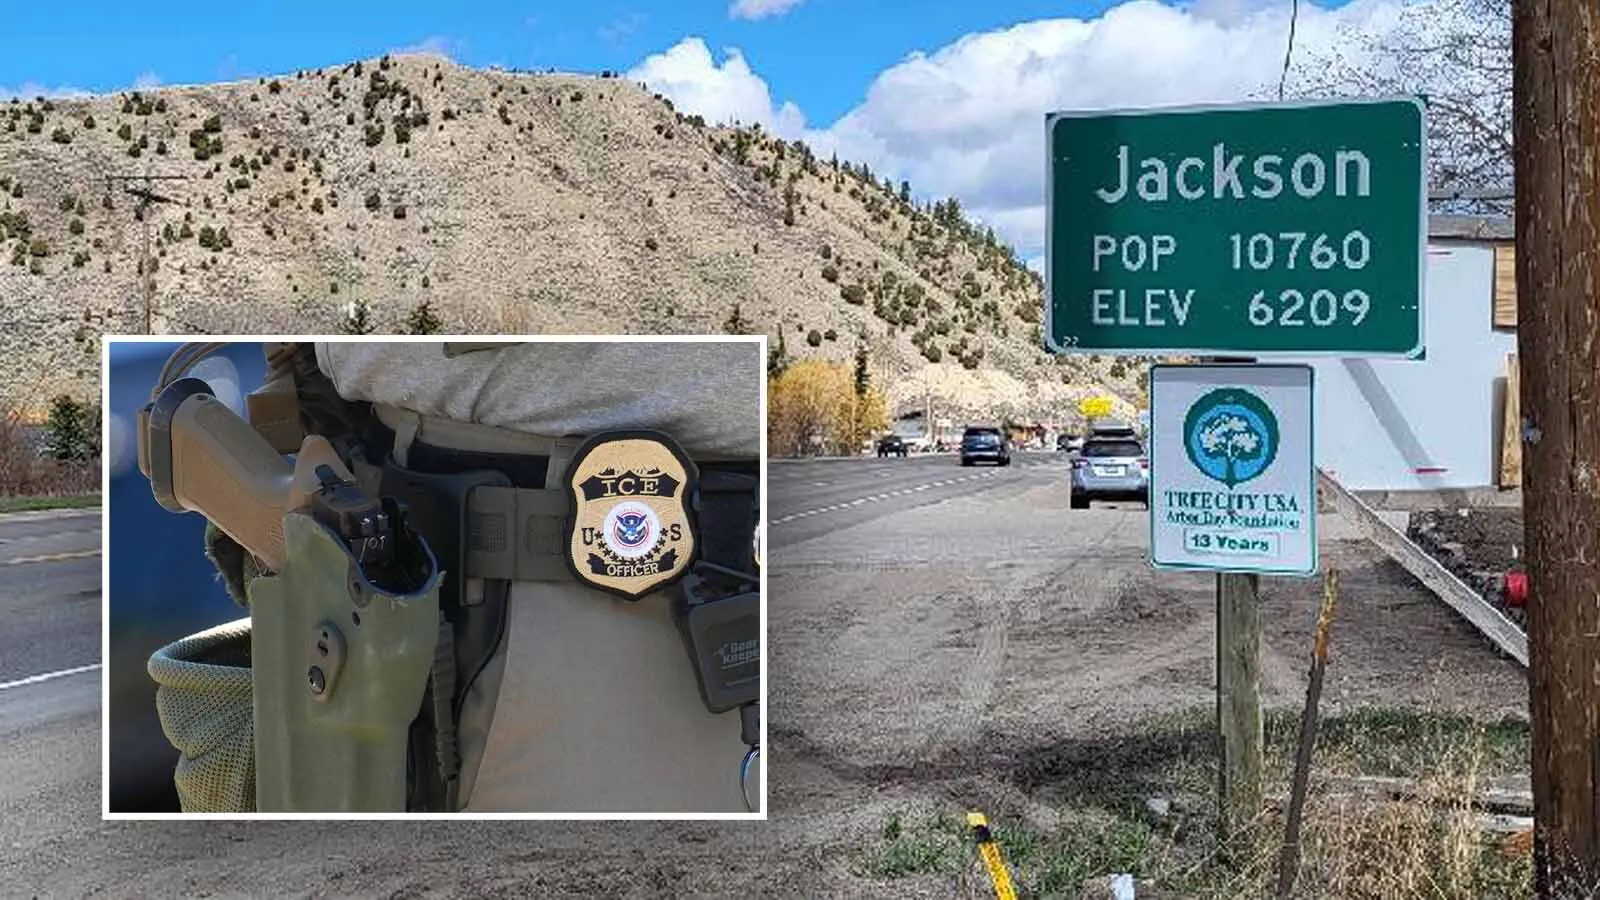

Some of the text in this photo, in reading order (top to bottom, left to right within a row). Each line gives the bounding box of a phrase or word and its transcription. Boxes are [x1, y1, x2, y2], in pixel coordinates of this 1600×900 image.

[1096, 142, 1371, 204] Jackson
[1092, 230, 1371, 272] POP 10760
[1092, 288, 1371, 327] ELEV 6209
[601, 477, 659, 497] ICE
[1164, 491, 1212, 510] TREE
[1215, 491, 1260, 511] CITY
[1166, 510, 1199, 526] Arbor
[1200, 511, 1226, 528] Day
[581, 523, 682, 545] U S
[1191, 533, 1270, 552] 13 Years
[606, 562, 660, 577] OFFICER
